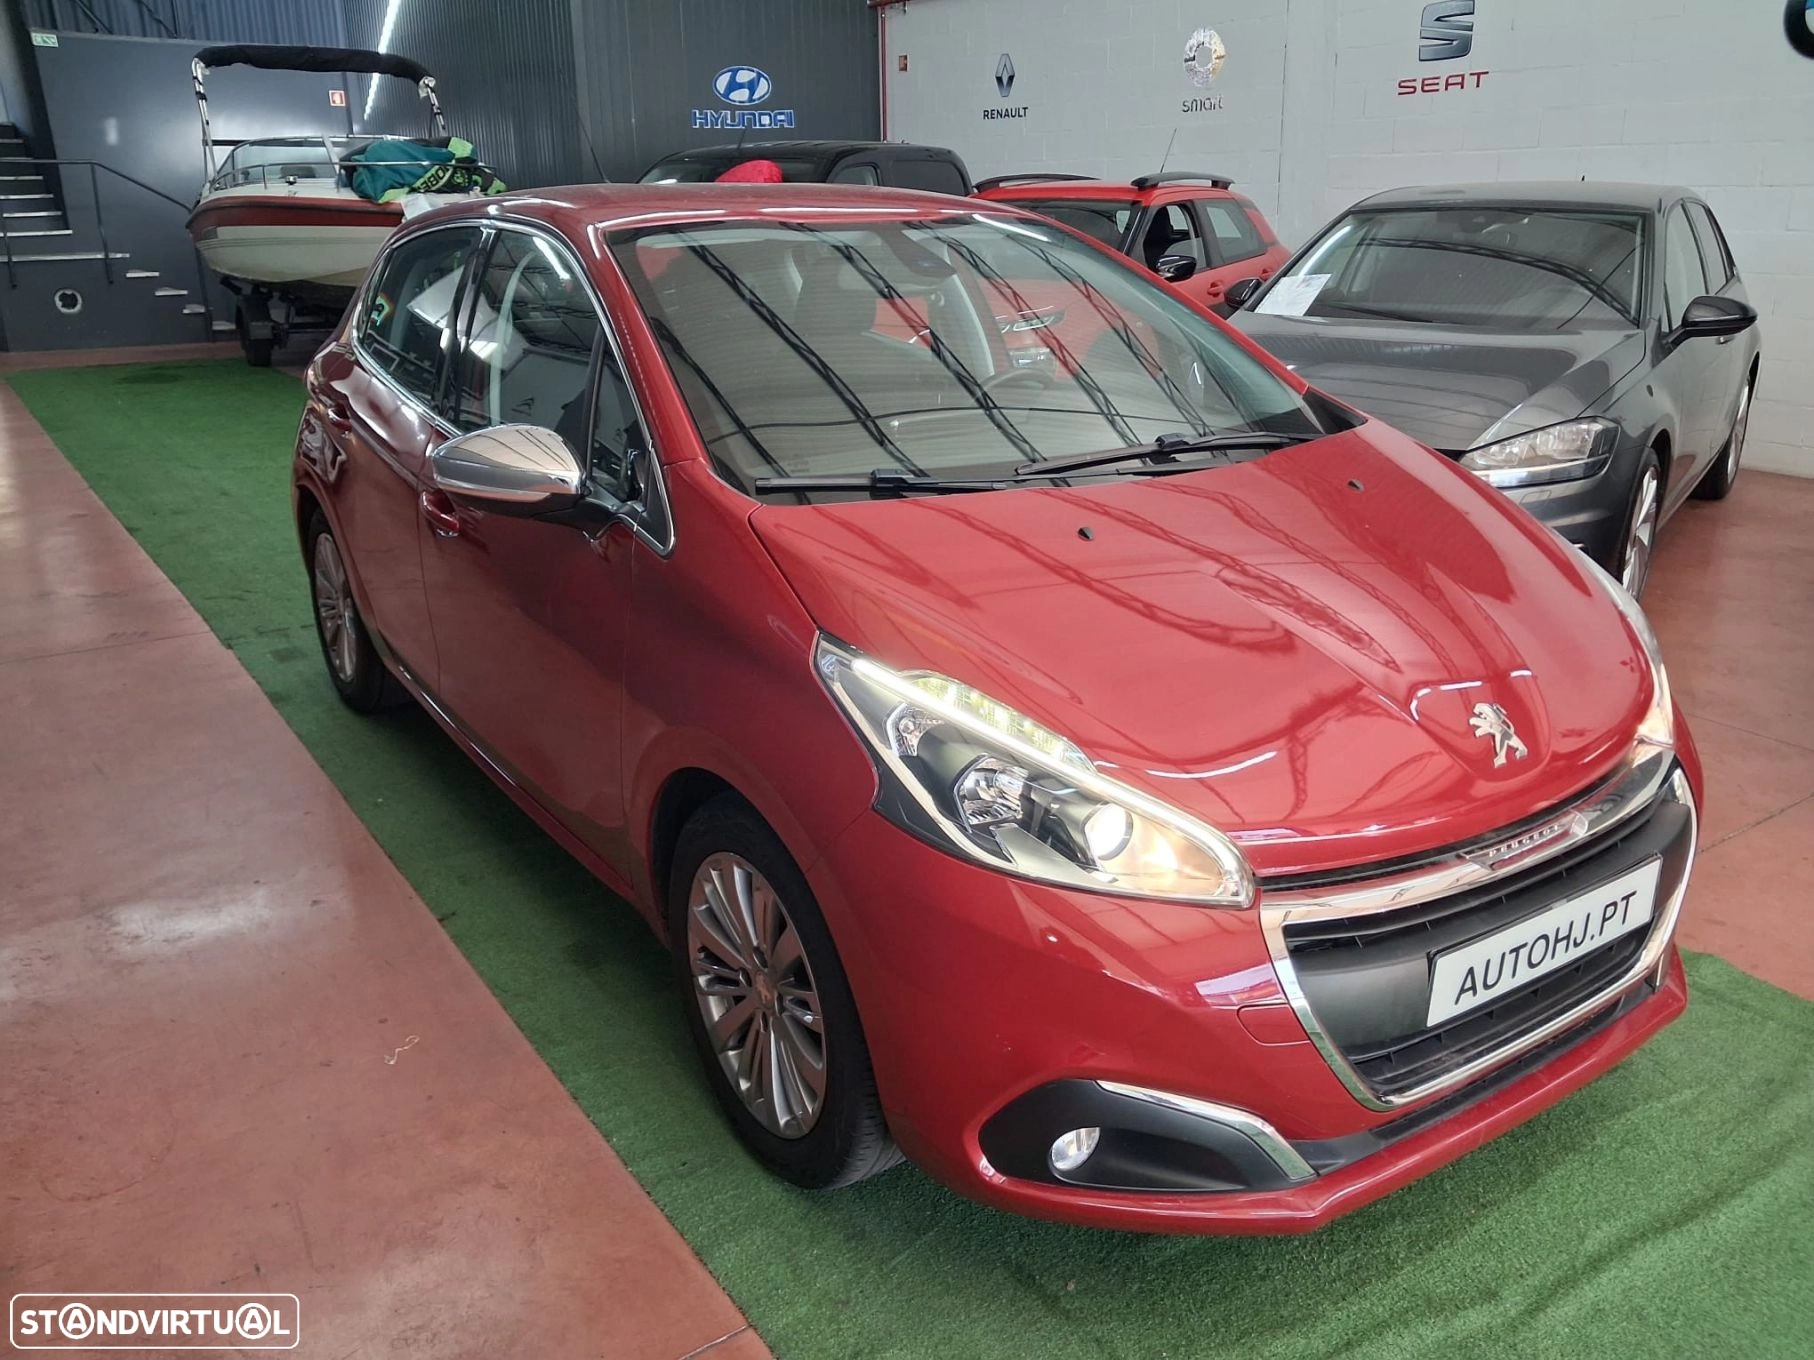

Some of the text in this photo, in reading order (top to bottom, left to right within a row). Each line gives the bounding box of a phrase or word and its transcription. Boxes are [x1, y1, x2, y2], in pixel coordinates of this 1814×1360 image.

[1398, 71, 1489, 95] SEAT
[983, 106, 1028, 120] RENAULT
[1182, 95, 1223, 112] smart
[691, 109, 795, 128] HYUNDAI
[1454, 890, 1637, 1006] AUTOHJ.PT
